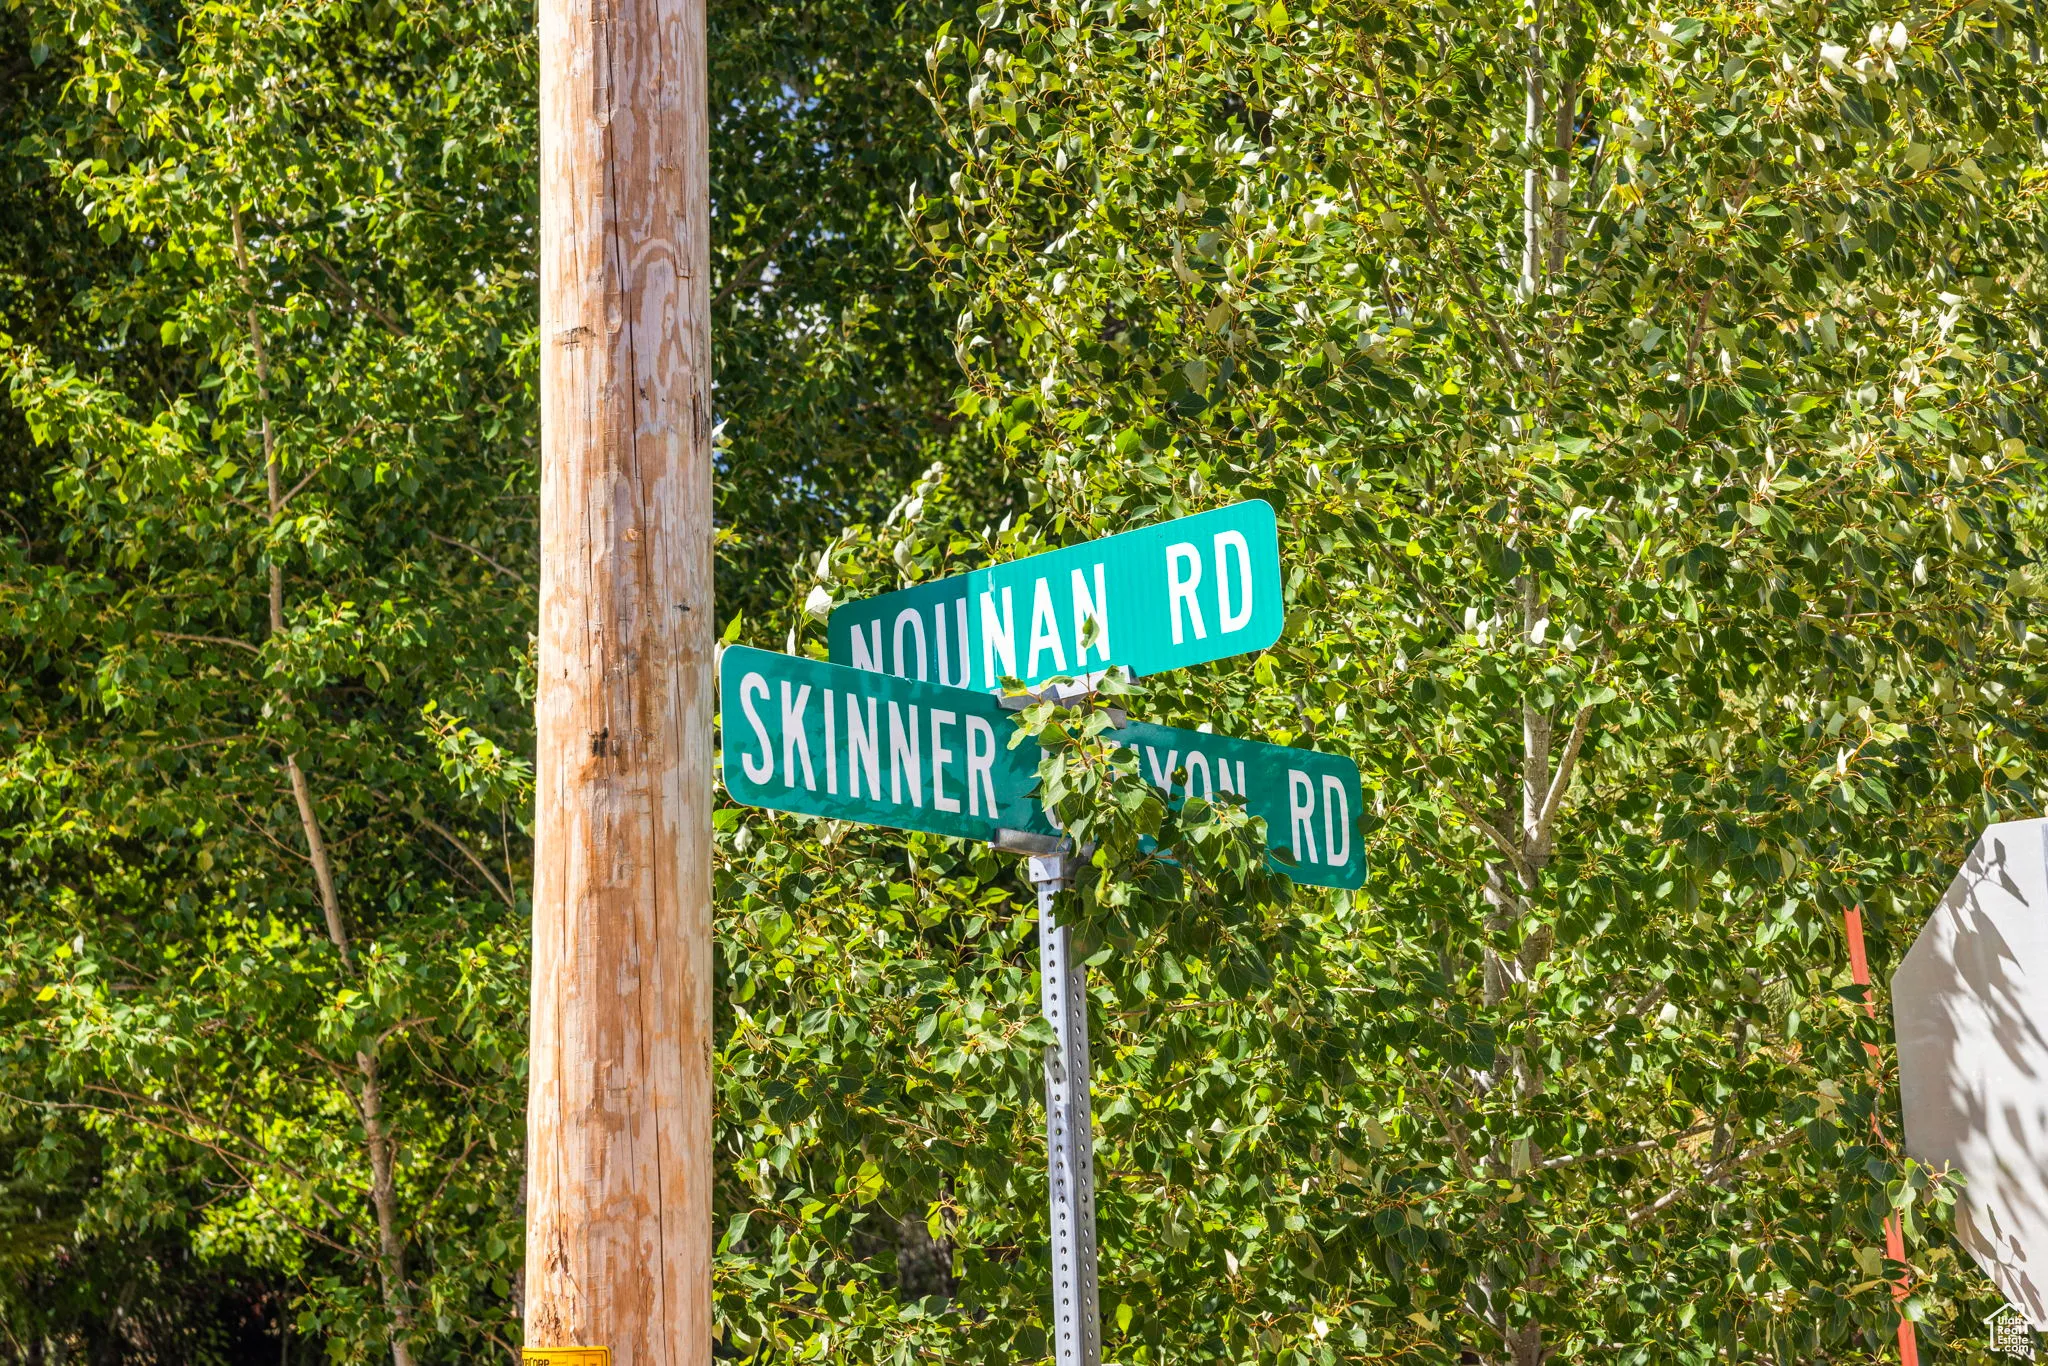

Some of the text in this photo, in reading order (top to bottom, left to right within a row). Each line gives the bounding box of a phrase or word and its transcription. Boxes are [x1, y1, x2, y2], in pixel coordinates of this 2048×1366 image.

[850, 529, 1253, 690] NOUNAN RD
[739, 671, 999, 820] SKINNER
[1287, 769, 1351, 867] RD
